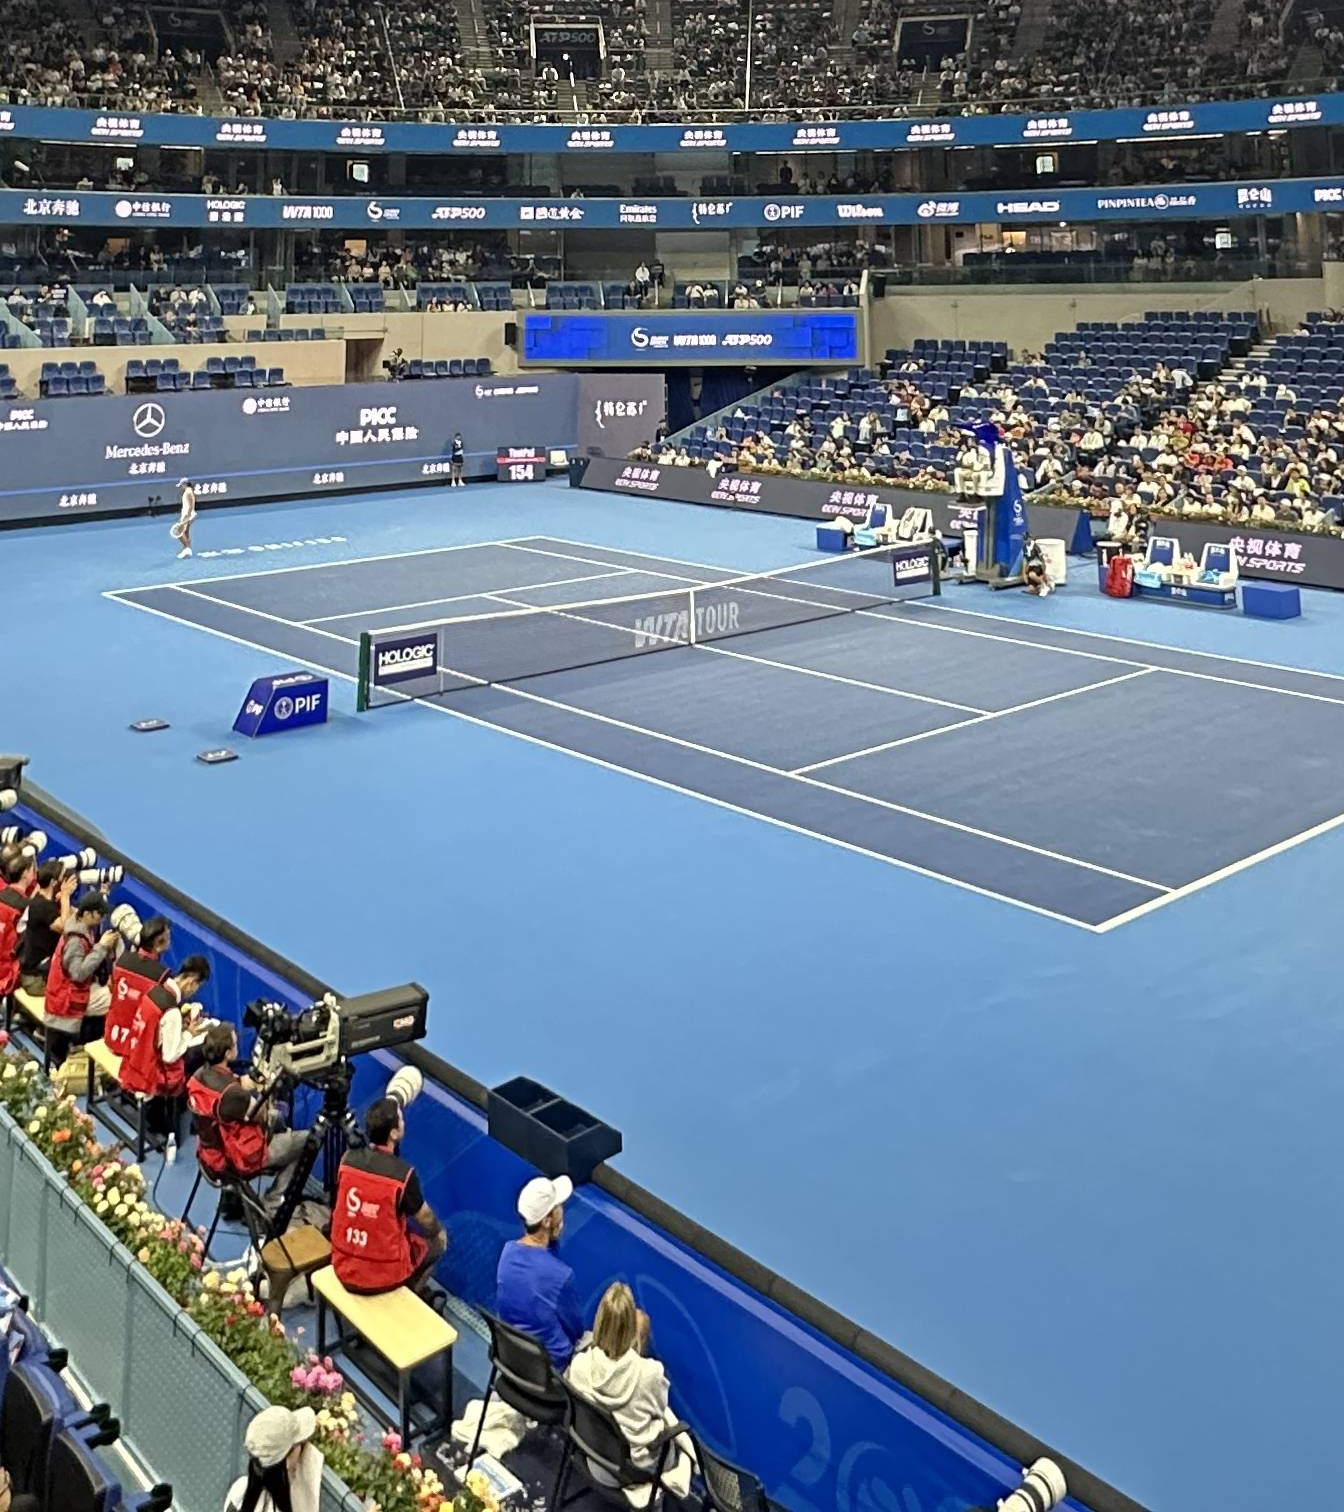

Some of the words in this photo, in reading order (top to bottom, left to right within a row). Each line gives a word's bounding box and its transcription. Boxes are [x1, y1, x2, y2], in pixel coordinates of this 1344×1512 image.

[781, 206, 804, 218] PIF
[837, 204, 883, 217] Wilson
[998, 201, 1059, 213] HEAD
[360, 407, 396, 426] PICC
[105, 442, 189, 459] Mercedes-Benz
[509, 465, 533, 479] 154
[1229, 536, 1303, 560] 央视体育
[895, 556, 929, 572] HOLOGIC
[1246, 557, 1306, 575] SPORTS
[695, 602, 740, 636] TOUR
[379, 644, 434, 667] HOLOGIC
[296, 695, 320, 712] PIF
[345, 1227, 368, 1247] 133
